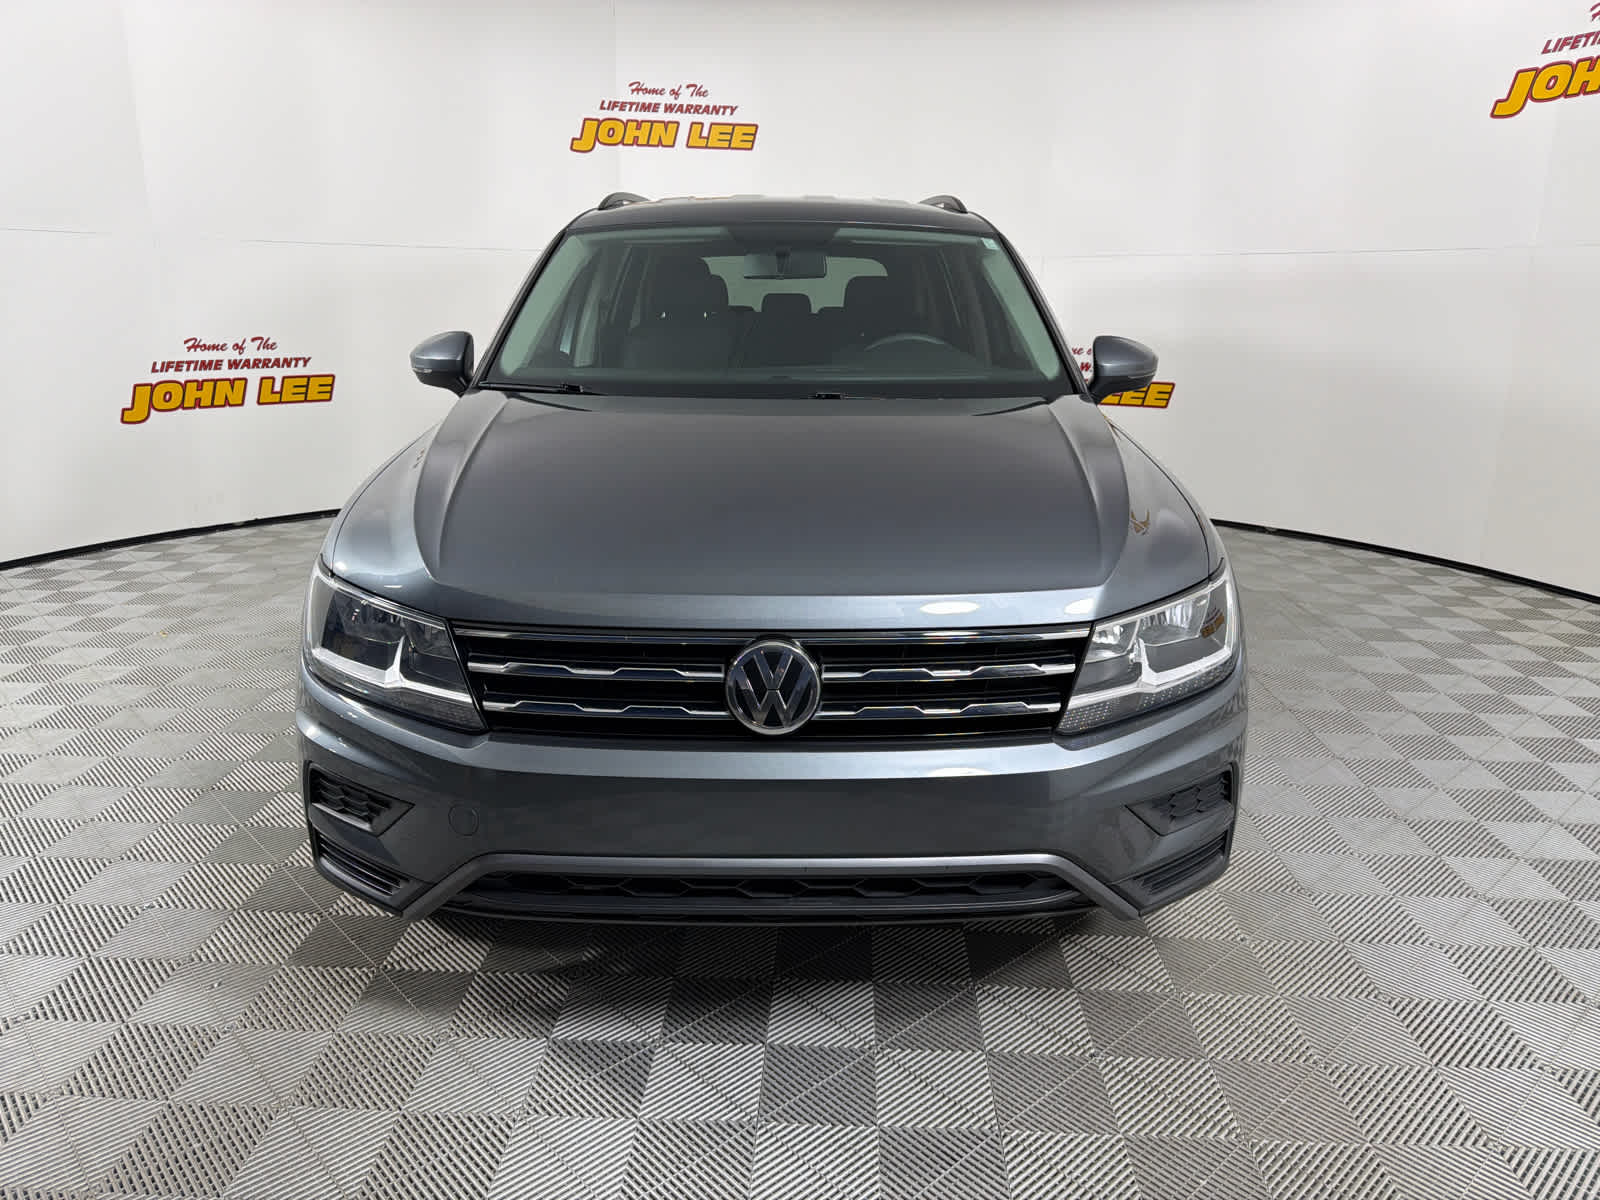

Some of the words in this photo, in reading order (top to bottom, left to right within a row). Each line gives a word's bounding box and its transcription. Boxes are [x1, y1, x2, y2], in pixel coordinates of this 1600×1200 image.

[1541, 30, 1600, 55] LIFETI
[628, 81, 666, 96] Home
[669, 84, 682, 100] of
[686, 84, 709, 98] The
[599, 100, 661, 113] LIFETIME
[663, 102, 738, 116] WARRANTY
[570, 117, 680, 153] JOHN
[686, 121, 759, 150] LEE
[183, 337, 228, 352] Home
[232, 338, 246, 355] of
[250, 336, 277, 351] The
[151, 359, 224, 373] LIFETIME
[227, 356, 311, 370] WARRANTY
[120, 377, 248, 424] JOHN
[256, 374, 336, 405] LEE
